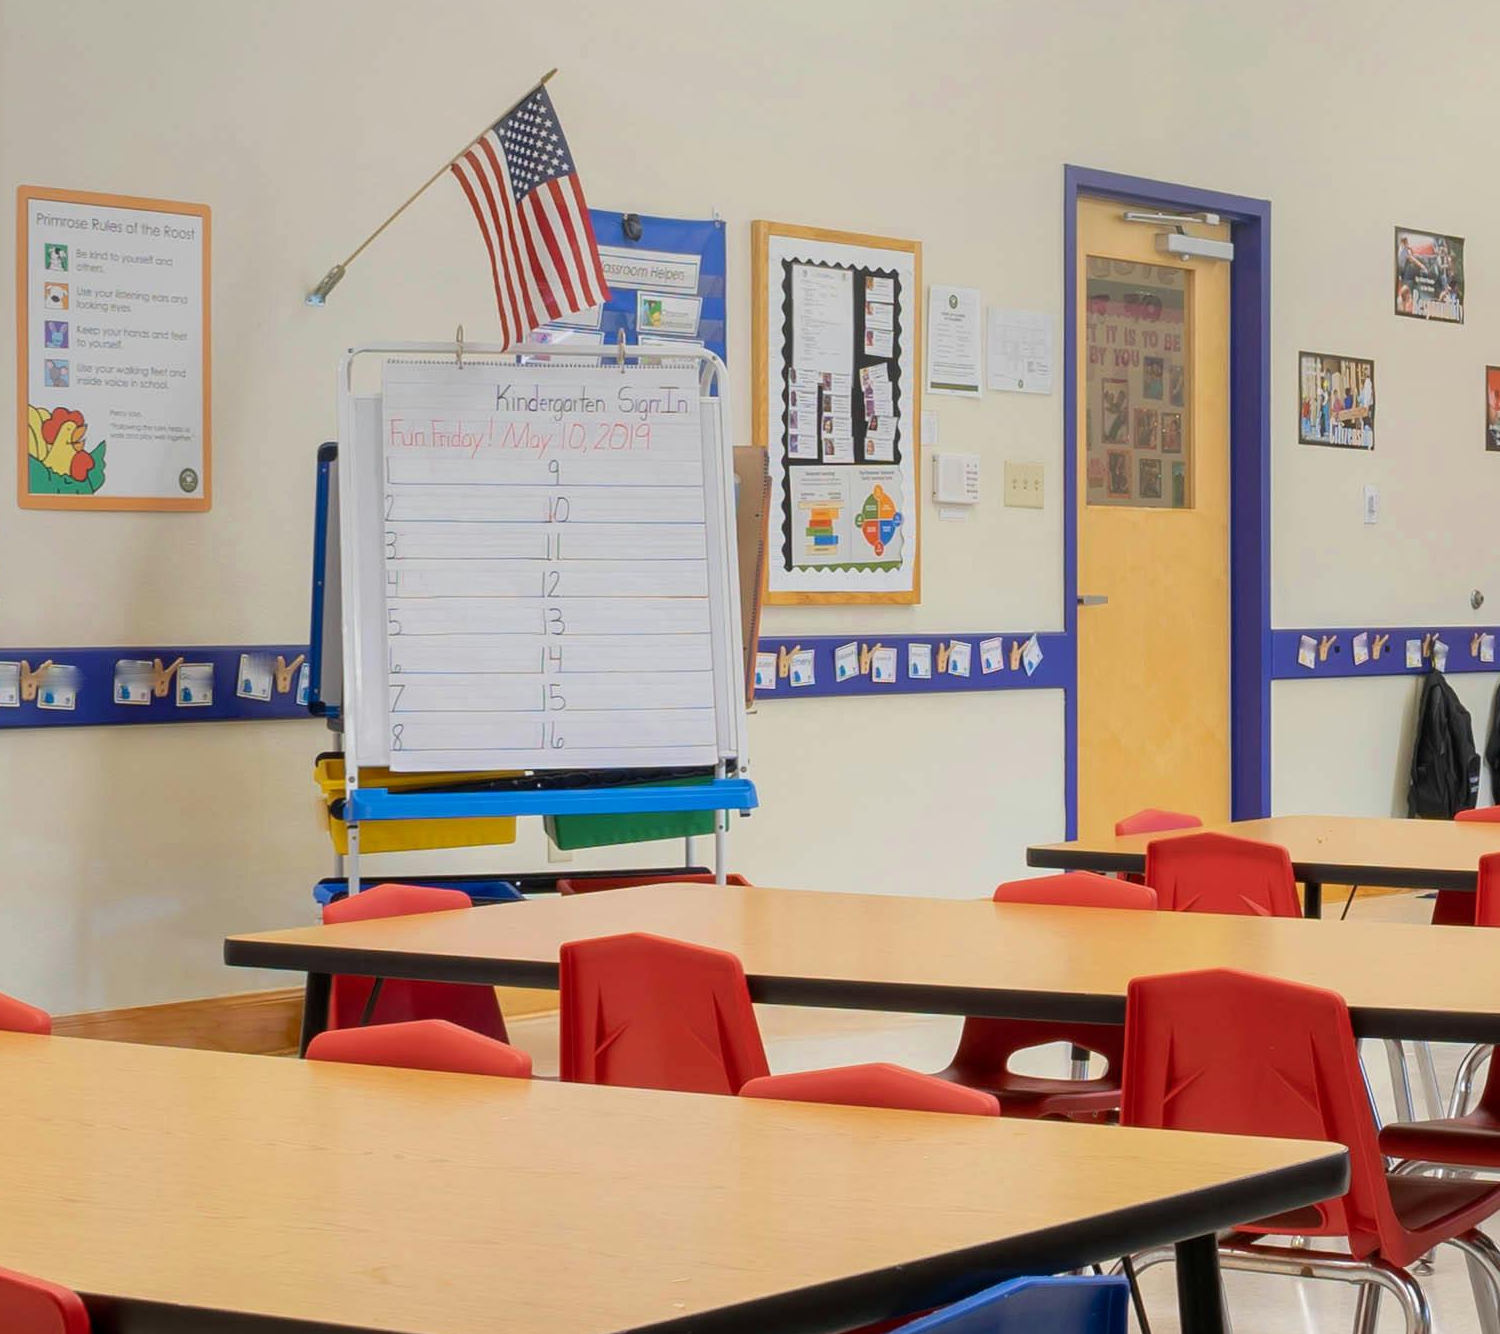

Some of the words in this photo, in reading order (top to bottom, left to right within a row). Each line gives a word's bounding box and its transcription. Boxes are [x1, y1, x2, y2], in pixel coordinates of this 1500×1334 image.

[36, 212, 88, 230] Primrose
[91, 219, 123, 233] Rules
[126, 222, 138, 235] of
[141, 223, 160, 237] the
[164, 226, 195, 240] Roost
[602, 261, 648, 278] lassroom
[496, 383, 605, 421] Kindergarten
[390, 419, 425, 447] Fun
[431, 417, 494, 459] Friday!
[501, 423, 552, 459] May
[561, 423, 588, 453] 10,
[593, 423, 651, 450] 2019
[548, 460, 560, 486] 9
[385, 495, 395, 522] 2
[549, 496, 570, 522] 10
[386, 532, 397, 559] 3
[547, 533, 560, 560] 11
[542, 571, 560, 597] 12
[388, 608, 402, 636] 5
[542, 608, 565, 635] 13
[389, 646, 402, 674] 6
[541, 645, 562, 674] 14
[388, 684, 405, 712] 7
[542, 684, 566, 711] 15
[392, 724, 404, 751] 8
[541, 721, 565, 749] 16
